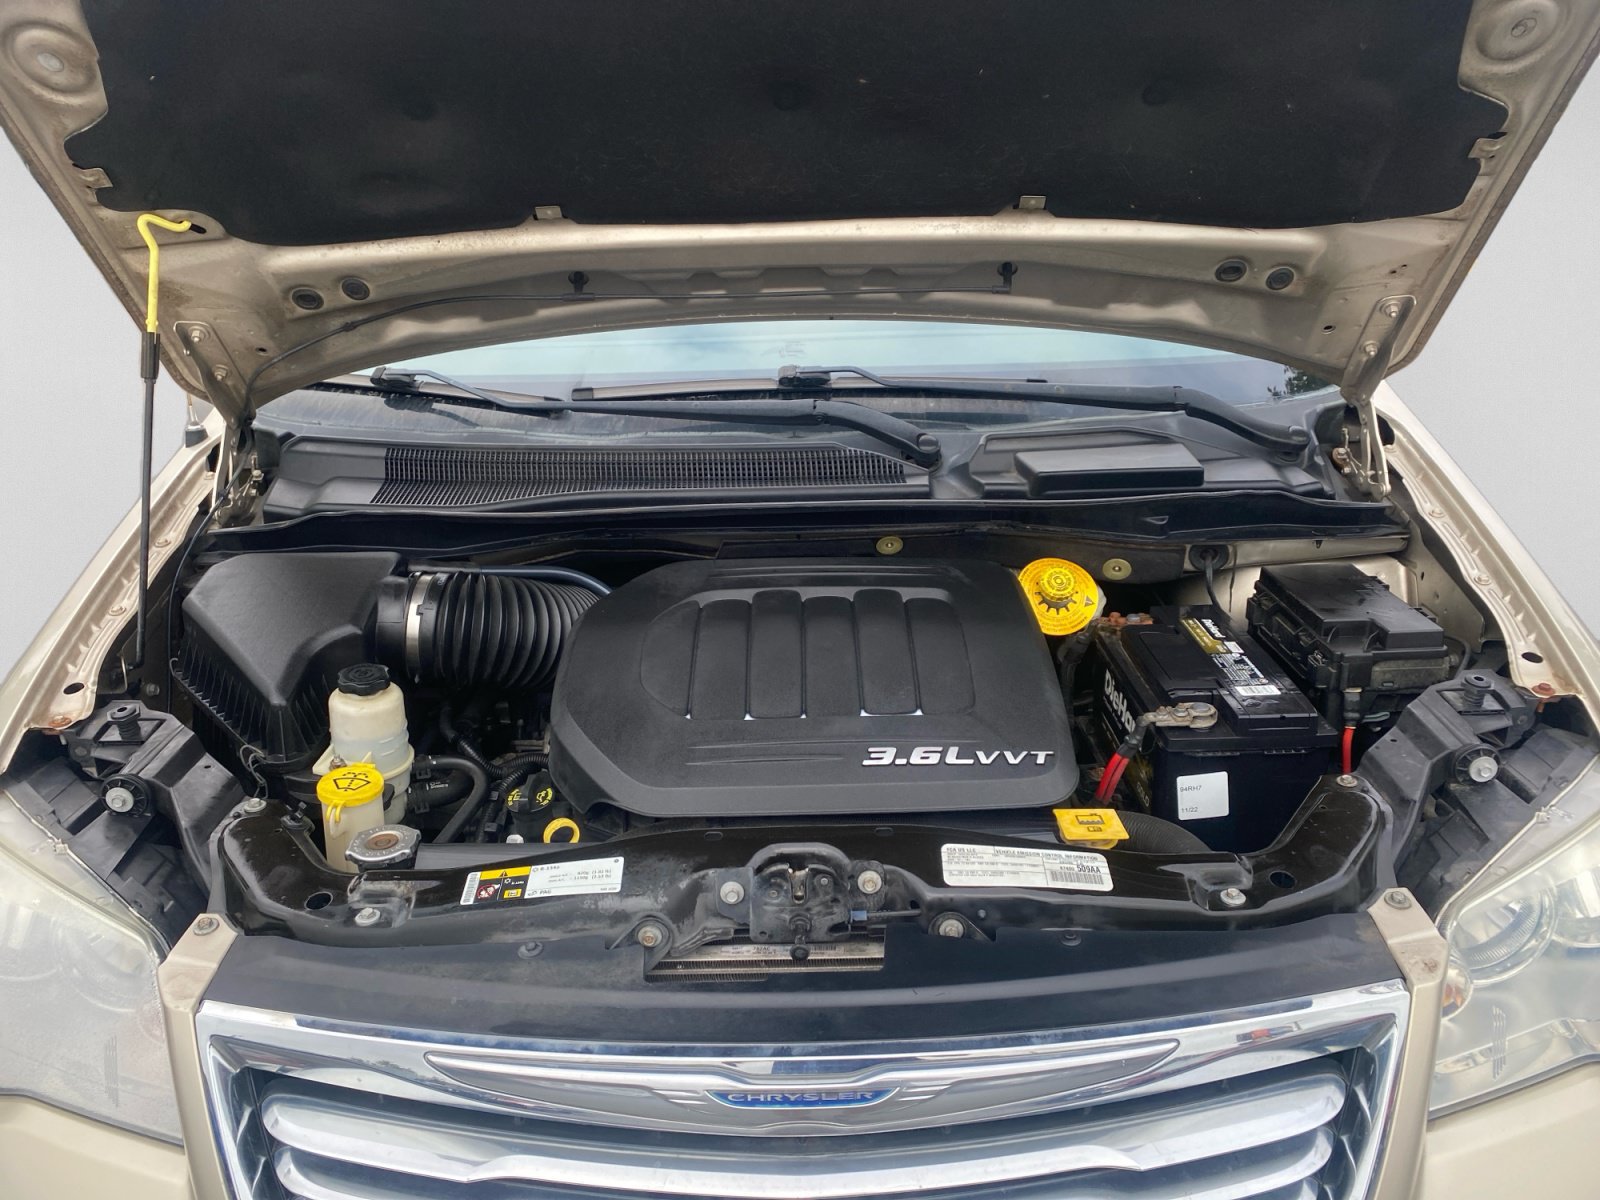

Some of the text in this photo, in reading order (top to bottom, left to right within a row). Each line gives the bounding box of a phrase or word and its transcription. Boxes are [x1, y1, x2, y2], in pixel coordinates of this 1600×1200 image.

[1104, 668, 1136, 734] DieHar
[1077, 864, 1101, 873] 509AA
[727, 1091, 873, 1102] CHRYSLER
